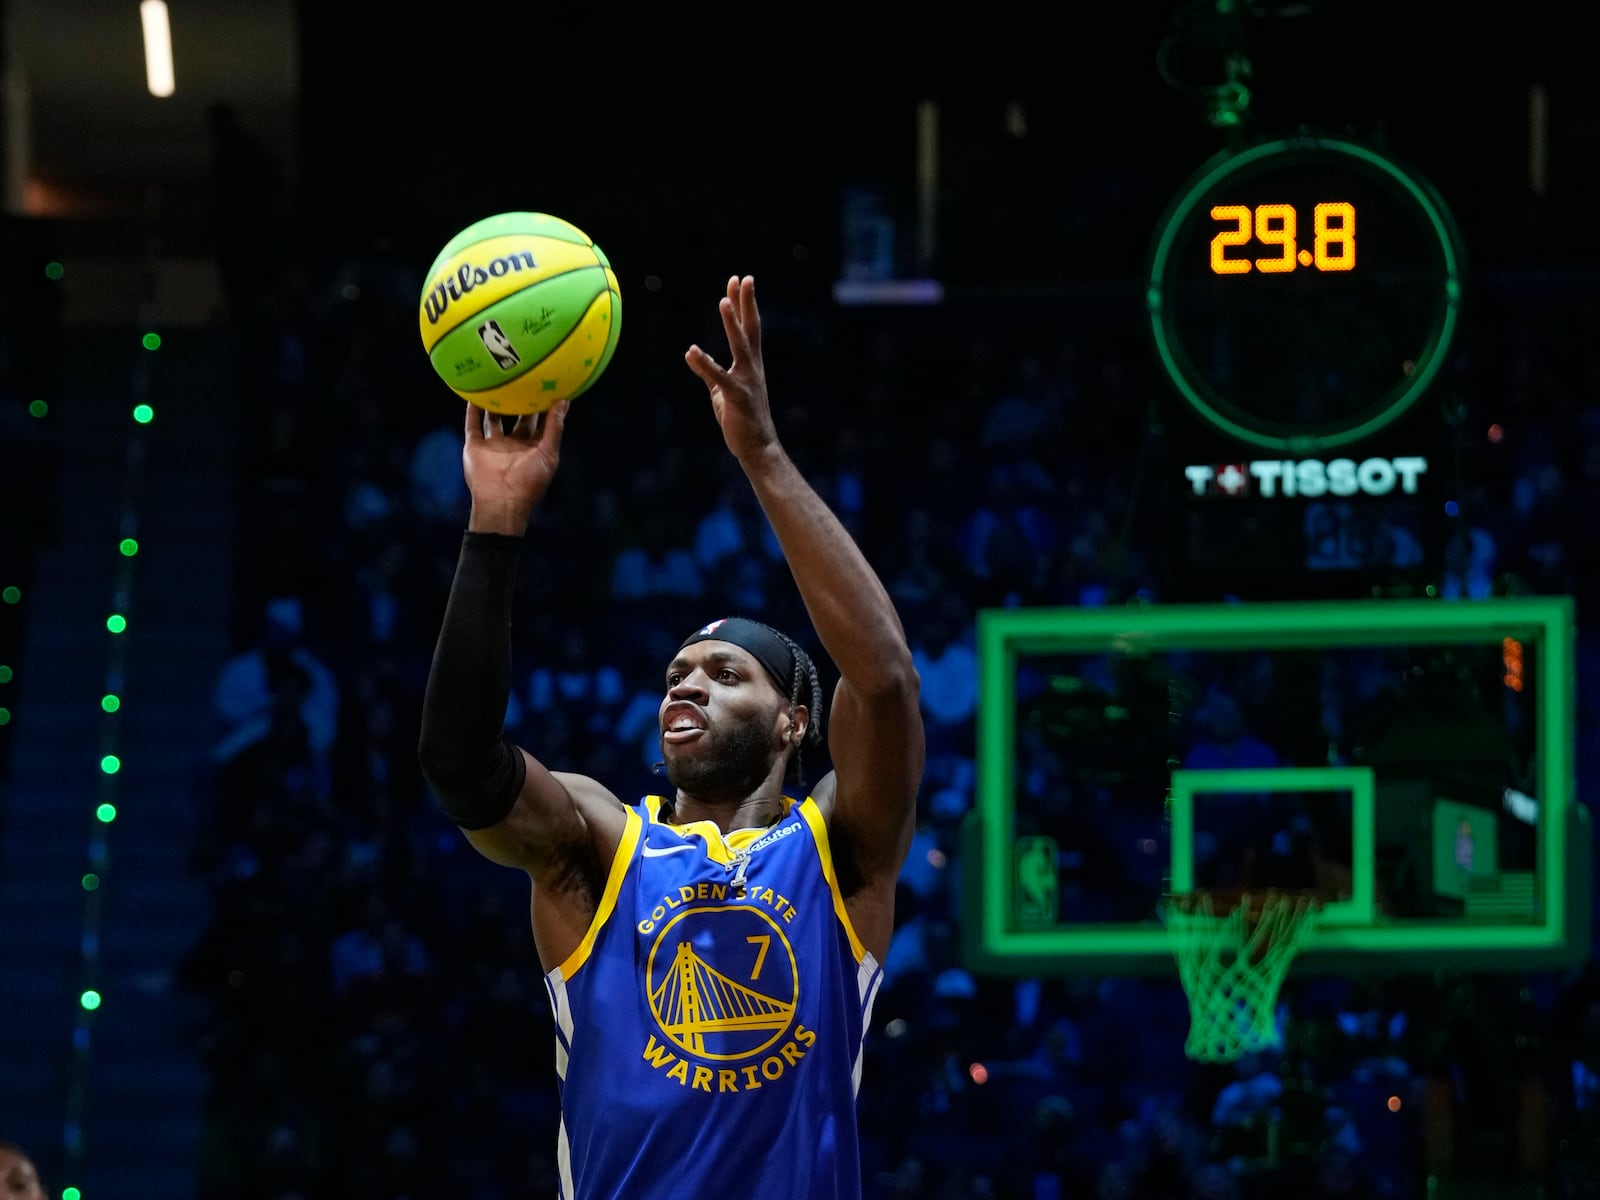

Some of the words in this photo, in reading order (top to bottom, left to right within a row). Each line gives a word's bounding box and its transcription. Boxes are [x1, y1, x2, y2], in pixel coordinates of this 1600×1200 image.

[1211, 202, 1356, 274] 29.8
[424, 250, 537, 325] Wilson
[1250, 457, 1427, 497] TISSOT
[748, 822, 802, 853] akuten
[638, 883, 727, 935] GOLDEN
[735, 885, 797, 924] STATE
[746, 935, 771, 981] 7
[642, 1024, 816, 1093] WARRIORS
